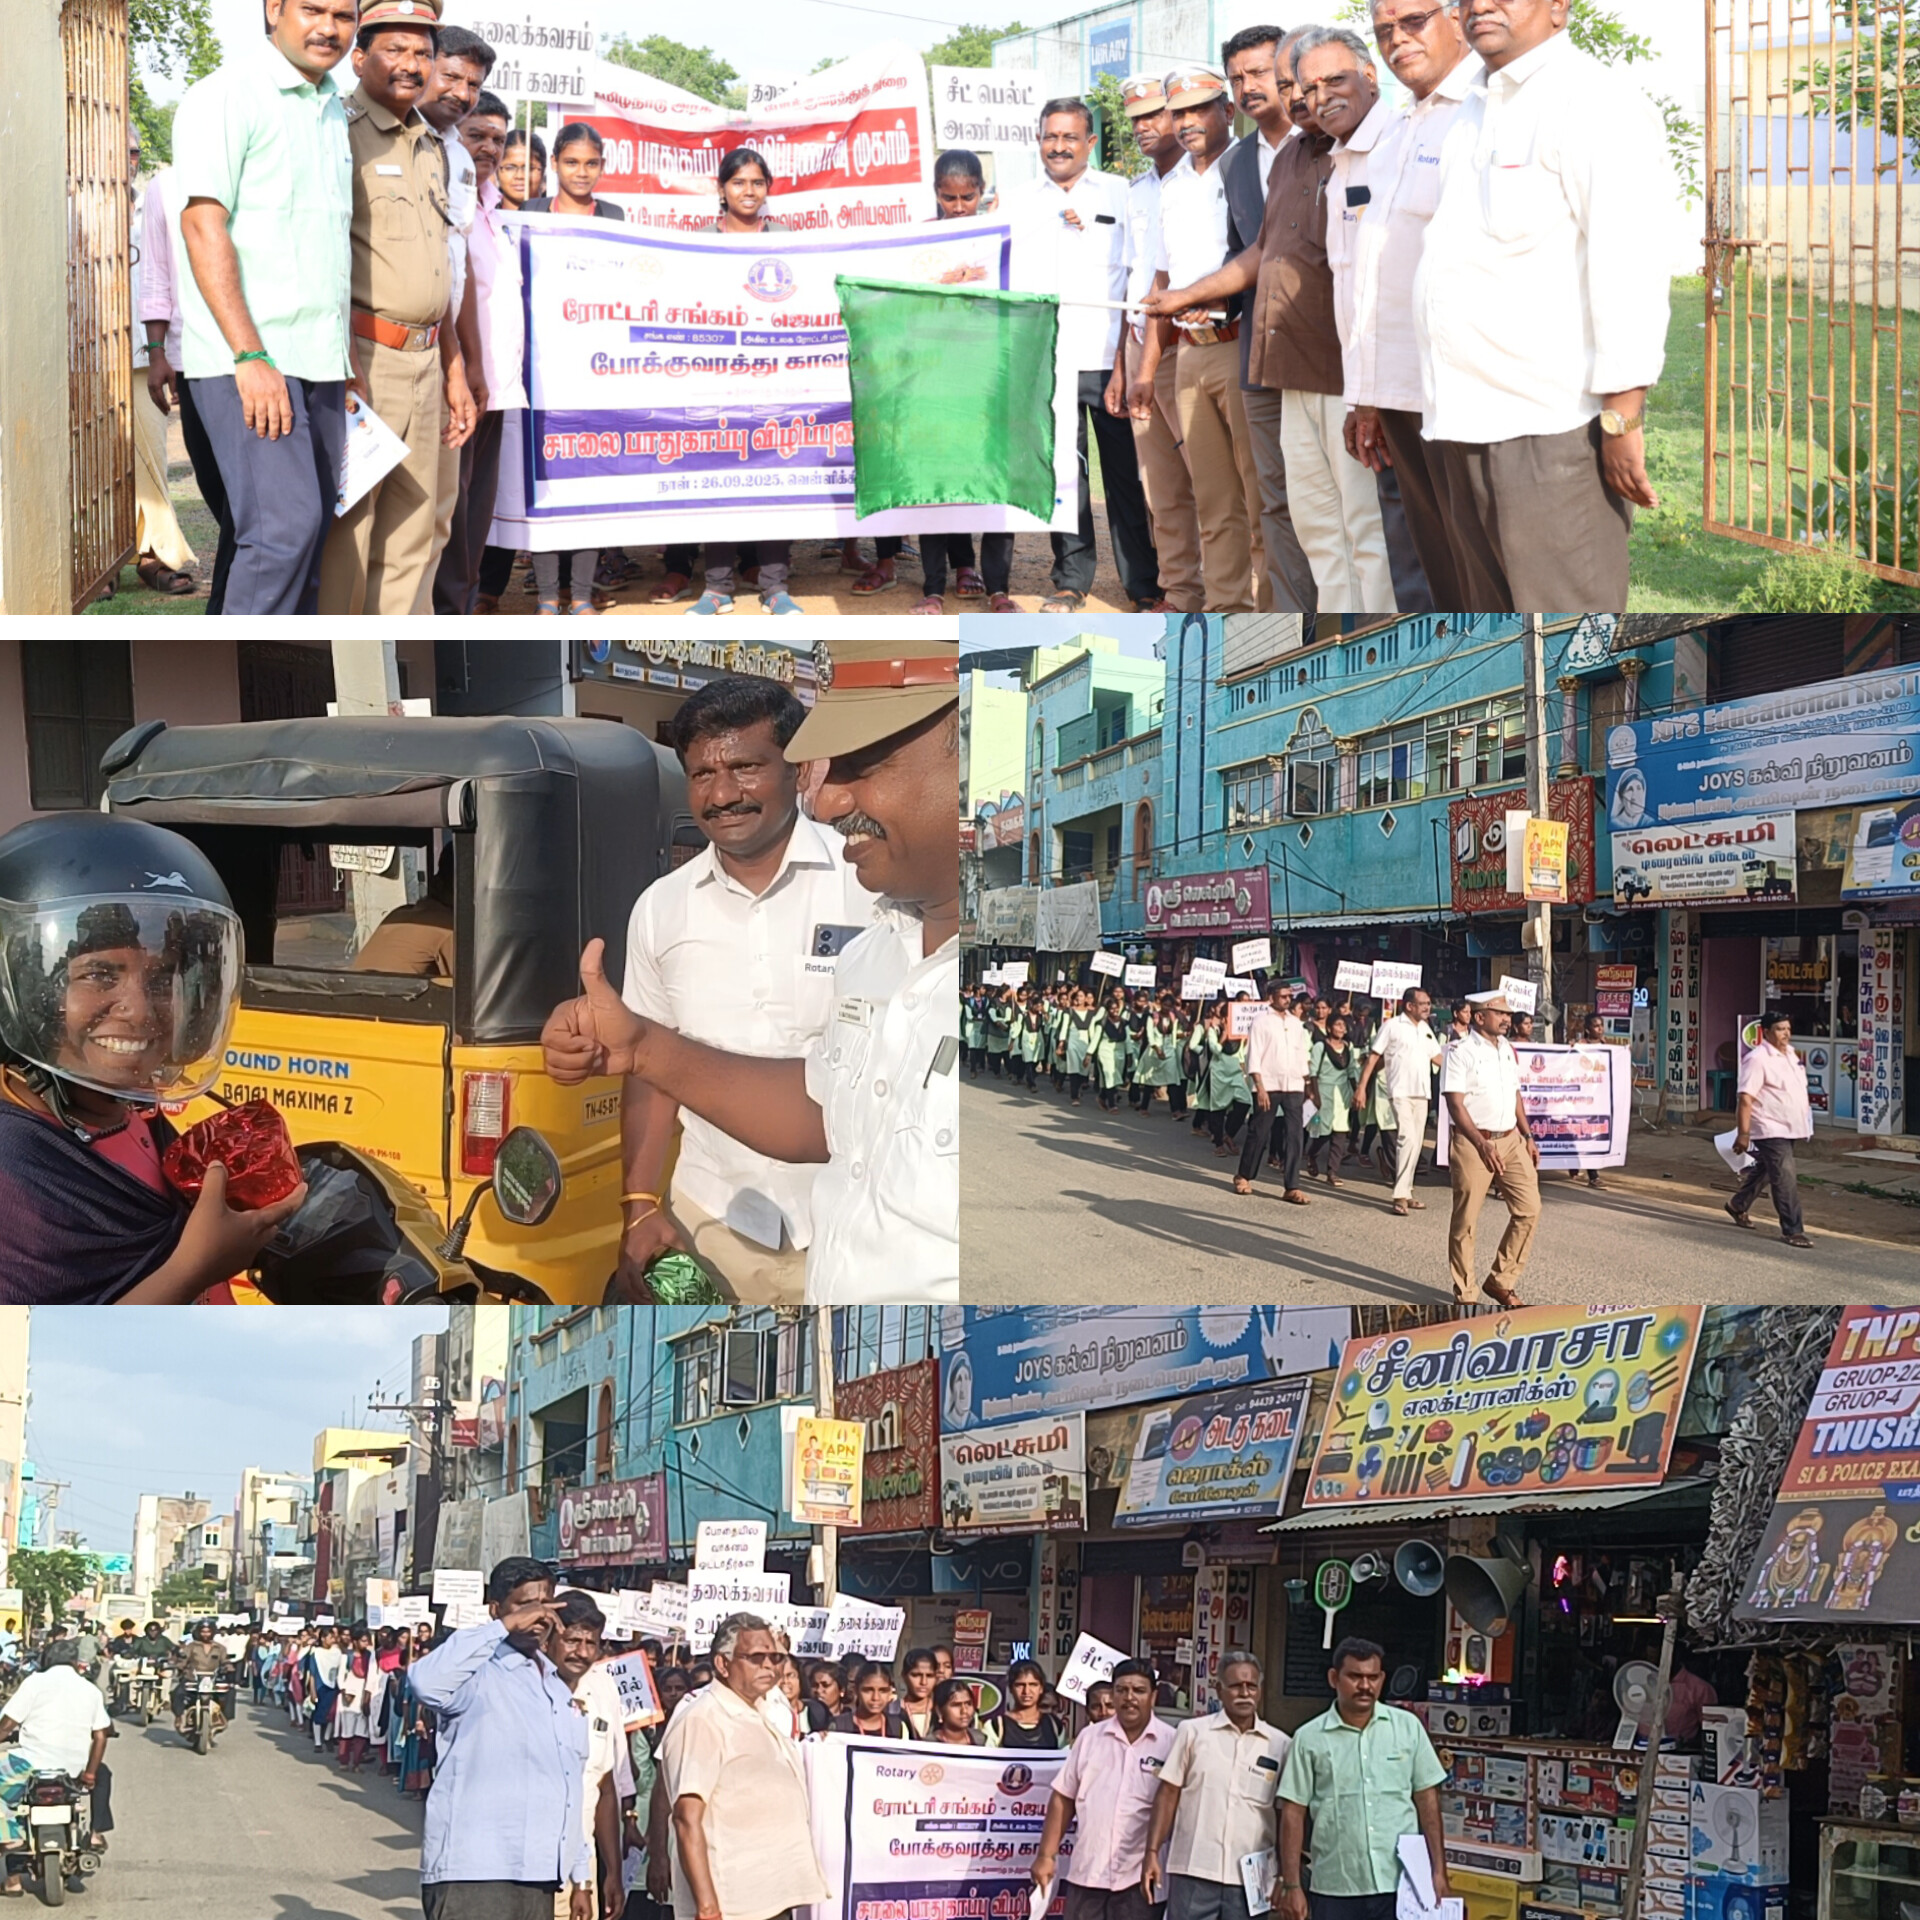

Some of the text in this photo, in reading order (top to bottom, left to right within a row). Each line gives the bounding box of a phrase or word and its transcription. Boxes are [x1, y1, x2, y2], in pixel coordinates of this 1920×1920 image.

[1091, 38, 1128, 66] LIBRARY
[526, 66, 585, 96] கவசம்
[946, 75, 1035, 106] சீட் பெல்ட்
[852, 118, 910, 178] முகாம்
[1417, 154, 1441, 166] Rotary
[562, 298, 659, 325] ரோட்டரி
[665, 301, 748, 328] சங்கம்
[692, 333, 725, 344] 85307
[590, 350, 779, 379] போக்குவரத்து
[542, 429, 621, 461] சாலை
[623, 417, 750, 466] பாதுகாப்பு
[1699, 769, 1745, 792] JOYS
[1747, 757, 1803, 786] கல்வி
[1804, 739, 1914, 784] நிறுவனம்
[1631, 821, 1776, 855] லெட்சுமி
[804, 963, 836, 976] Rotary
[225, 1050, 349, 1079] OUND HORN
[273, 1087, 339, 1115] MAXIMA
[343, 1096, 353, 1115] Z
[585, 1096, 621, 1120] TN-45-BT-
[1014, 1319, 1189, 1383] JOYS கல்வி நிறுவனம்
[1366, 1314, 1656, 1396] சீனிவாசா
[1824, 1389, 1903, 1412] GRUOP-4
[956, 1425, 1070, 1465] லெட்சுமி
[1813, 1416, 1920, 1454] TNUSR
[826, 1444, 856, 1457] APN
[1797, 1465, 1813, 1484] SI
[1829, 1462, 1885, 1482] POLICE
[951, 1560, 1022, 1582] VVO
[691, 1577, 786, 1604] தலைக்கவசம்
[875, 1764, 917, 1781] Rotary
[873, 1796, 936, 1817] ரோட்டரி
[939, 1796, 996, 1818] சங்கம்
[889, 1838, 1014, 1861] போக்குவரத்து
